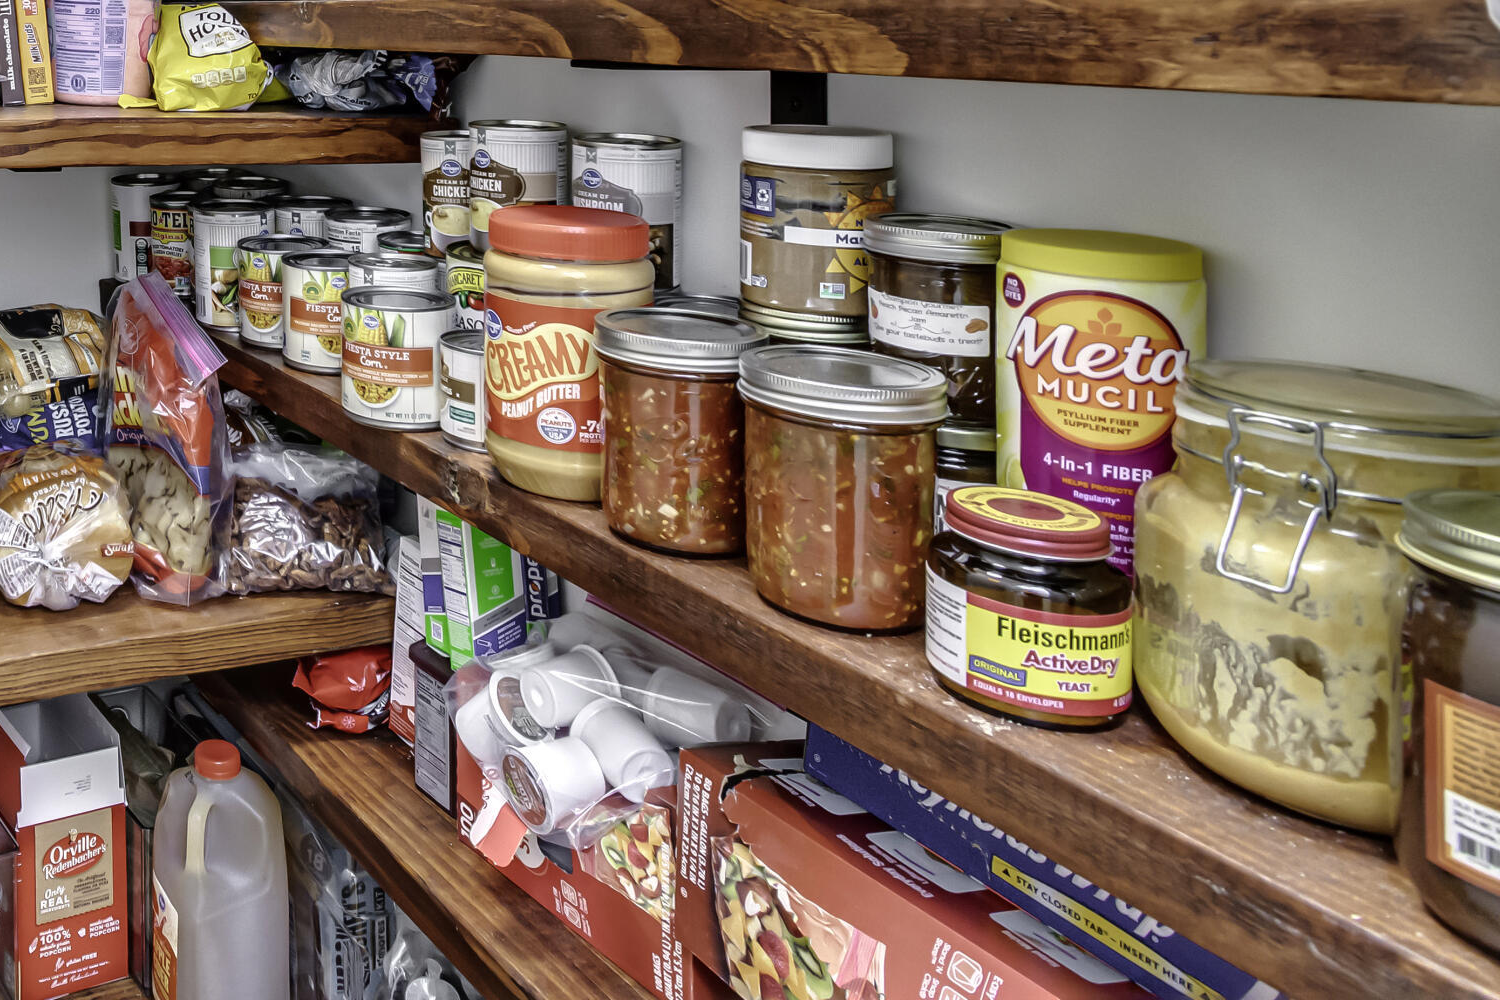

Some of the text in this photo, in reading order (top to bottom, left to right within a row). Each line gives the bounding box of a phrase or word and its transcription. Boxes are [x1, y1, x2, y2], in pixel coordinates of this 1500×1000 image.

[85, 7, 100, 15] 220
[196, 11, 241, 27] TOLL
[3, 17, 16, 90] milk chocolate
[436, 178, 457, 186] CREAM
[578, 191, 597, 199] CREAM
[1006, 278, 1018, 287] NO
[1005, 290, 1022, 301] DYES
[306, 303, 341, 315] FIESTA
[345, 341, 410, 361] FIESTA STYLE
[1005, 315, 1189, 385] Meta
[360, 356, 384, 369] Corn
[486, 332, 589, 393] CREAMY
[501, 383, 581, 418] PEANUT BUTTER
[1037, 372, 1164, 412] MUCIL
[540, 416, 572, 428] PEANUTS
[1057, 408, 1139, 428] PSYLLIUM FIBER
[548, 431, 564, 440] USA
[1063, 419, 1131, 436] SUPPLEMENT
[1043, 452, 1153, 482] 4-in-1 FIBER
[1062, 476, 1134, 495] HELPS PROMOTE
[997, 615, 1130, 651] Fleischmann's
[973, 659, 1021, 682] ORIGINAL
[1021, 650, 1119, 678] Active Dry
[973, 679, 1064, 709] EQUALS ENVELOPES
[1057, 680, 1091, 693] YEAST
[699, 788, 712, 850] BAGS GALLON
[50, 835, 97, 864] Orville
[42, 845, 107, 881] Redenbacher's
[44, 885, 66, 900] Only
[40, 895, 70, 909] REAL
[89, 919, 120, 932] NON-GMO
[89, 926, 120, 939] POPCORN
[1016, 875, 1195, 993] STAY CLOSED TAB INSERT HERE
[39, 929, 71, 945] 100%
[39, 945, 72, 959] POPCORN
[81, 952, 98, 963] FREE
[651, 953, 663, 992] 100 BAGS
